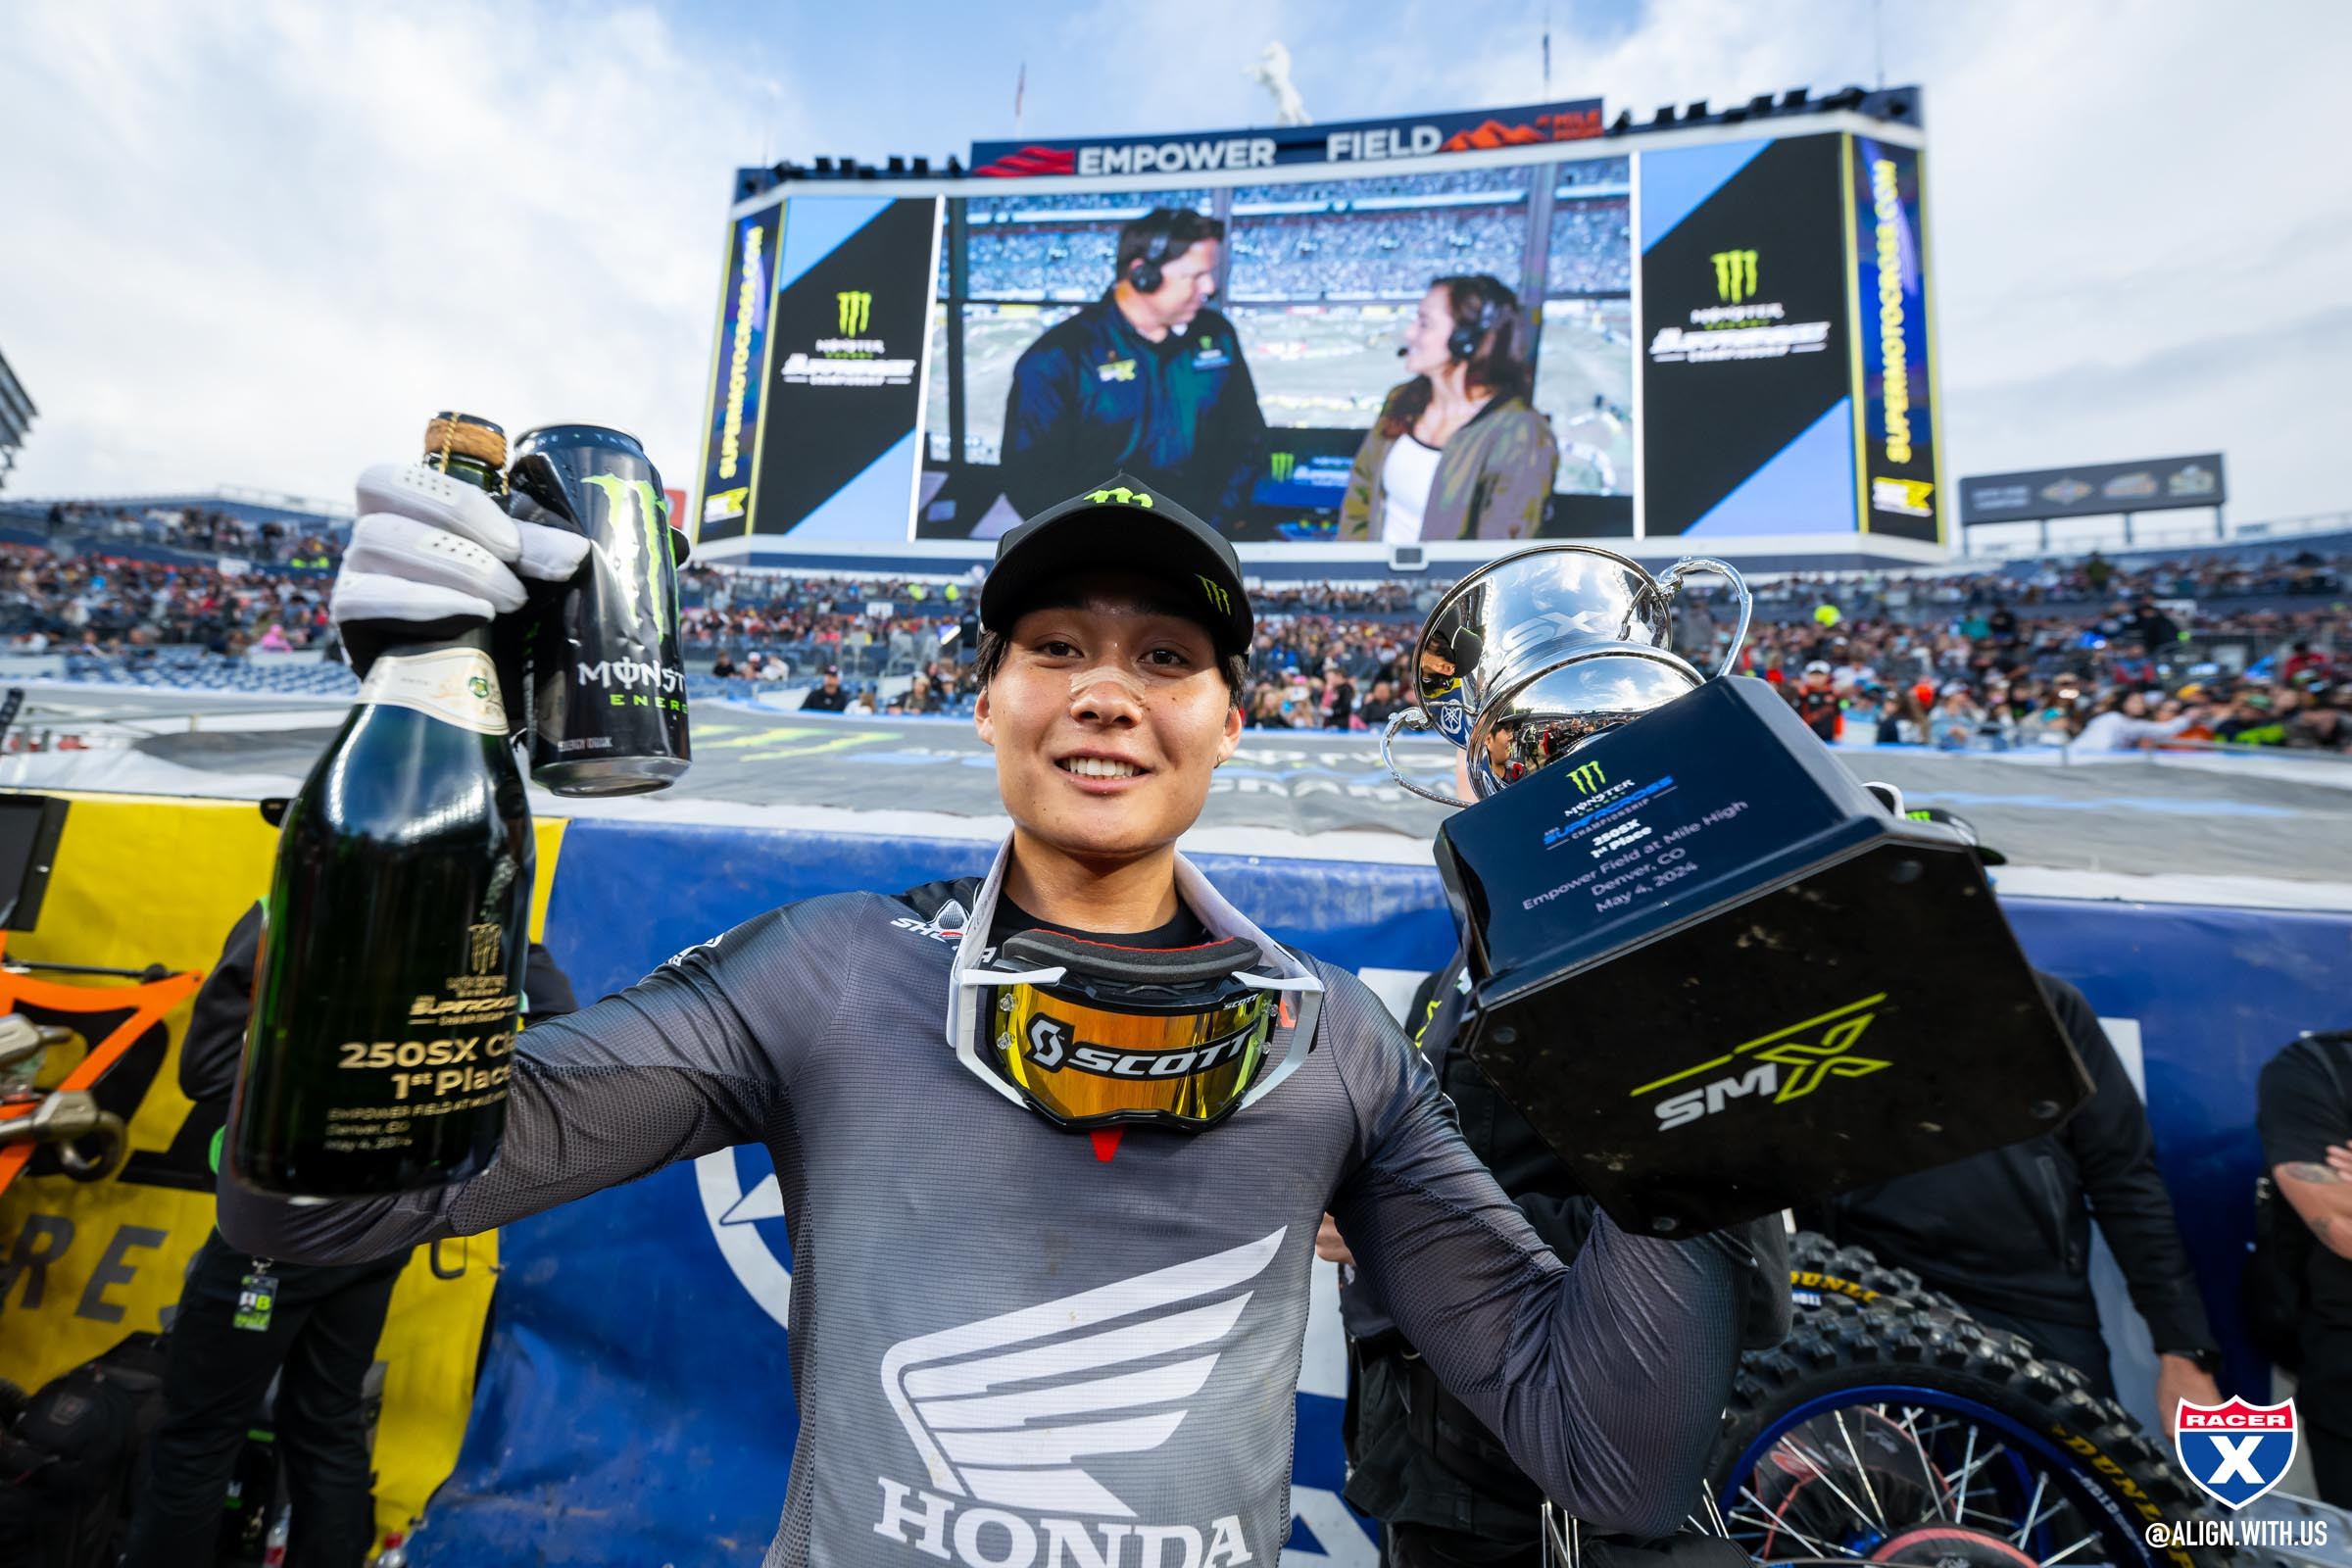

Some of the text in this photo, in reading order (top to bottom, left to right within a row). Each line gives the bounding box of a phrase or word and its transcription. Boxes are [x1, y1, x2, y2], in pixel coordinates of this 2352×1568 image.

[1079, 124, 1444, 176] EMPOWER FIELD
[1564, 779, 1636, 817] MONSTER
[1572, 798, 1650, 840] CHAMPIONSHIP
[1522, 800, 1749, 910] Empower Field at Mile High
[1592, 818, 1641, 846] 250SX
[1608, 826, 1653, 852] Place
[1591, 847, 1687, 897] Denver, CO
[1595, 861, 1699, 913] May 4, 2024
[1224, 993, 1259, 1010] SCOTT
[337, 1037, 480, 1069] 250SX
[1068, 1029, 1253, 1076] SCOTT
[1654, 1013, 1893, 1132] SMX
[873, 1477, 1252, 1568] HONDA
